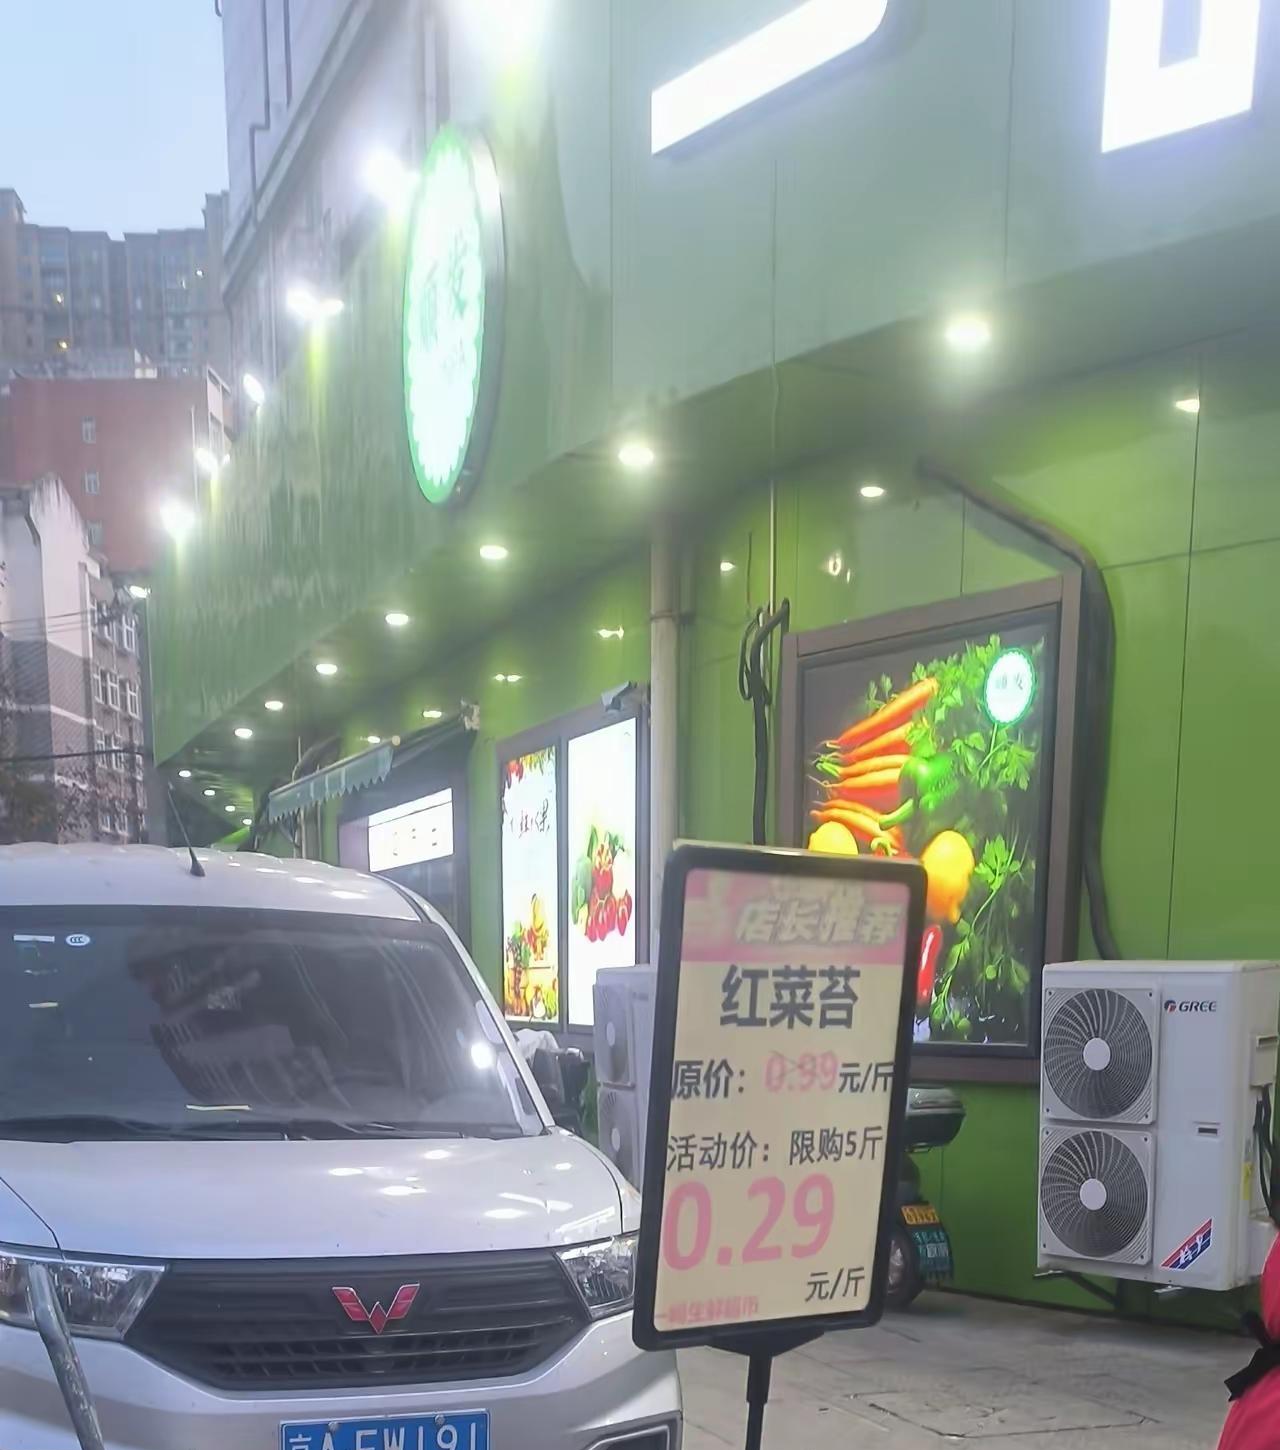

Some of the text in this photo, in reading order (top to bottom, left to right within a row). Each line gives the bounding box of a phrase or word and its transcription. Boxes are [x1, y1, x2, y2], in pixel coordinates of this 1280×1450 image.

[737, 892, 900, 945] 店长推荐
[720, 964, 861, 1029] 红菜苔
[1179, 1001, 1216, 1012] GREE
[663, 1173, 834, 1271] 0.29
[805, 1267, 865, 1302] 元/斤
